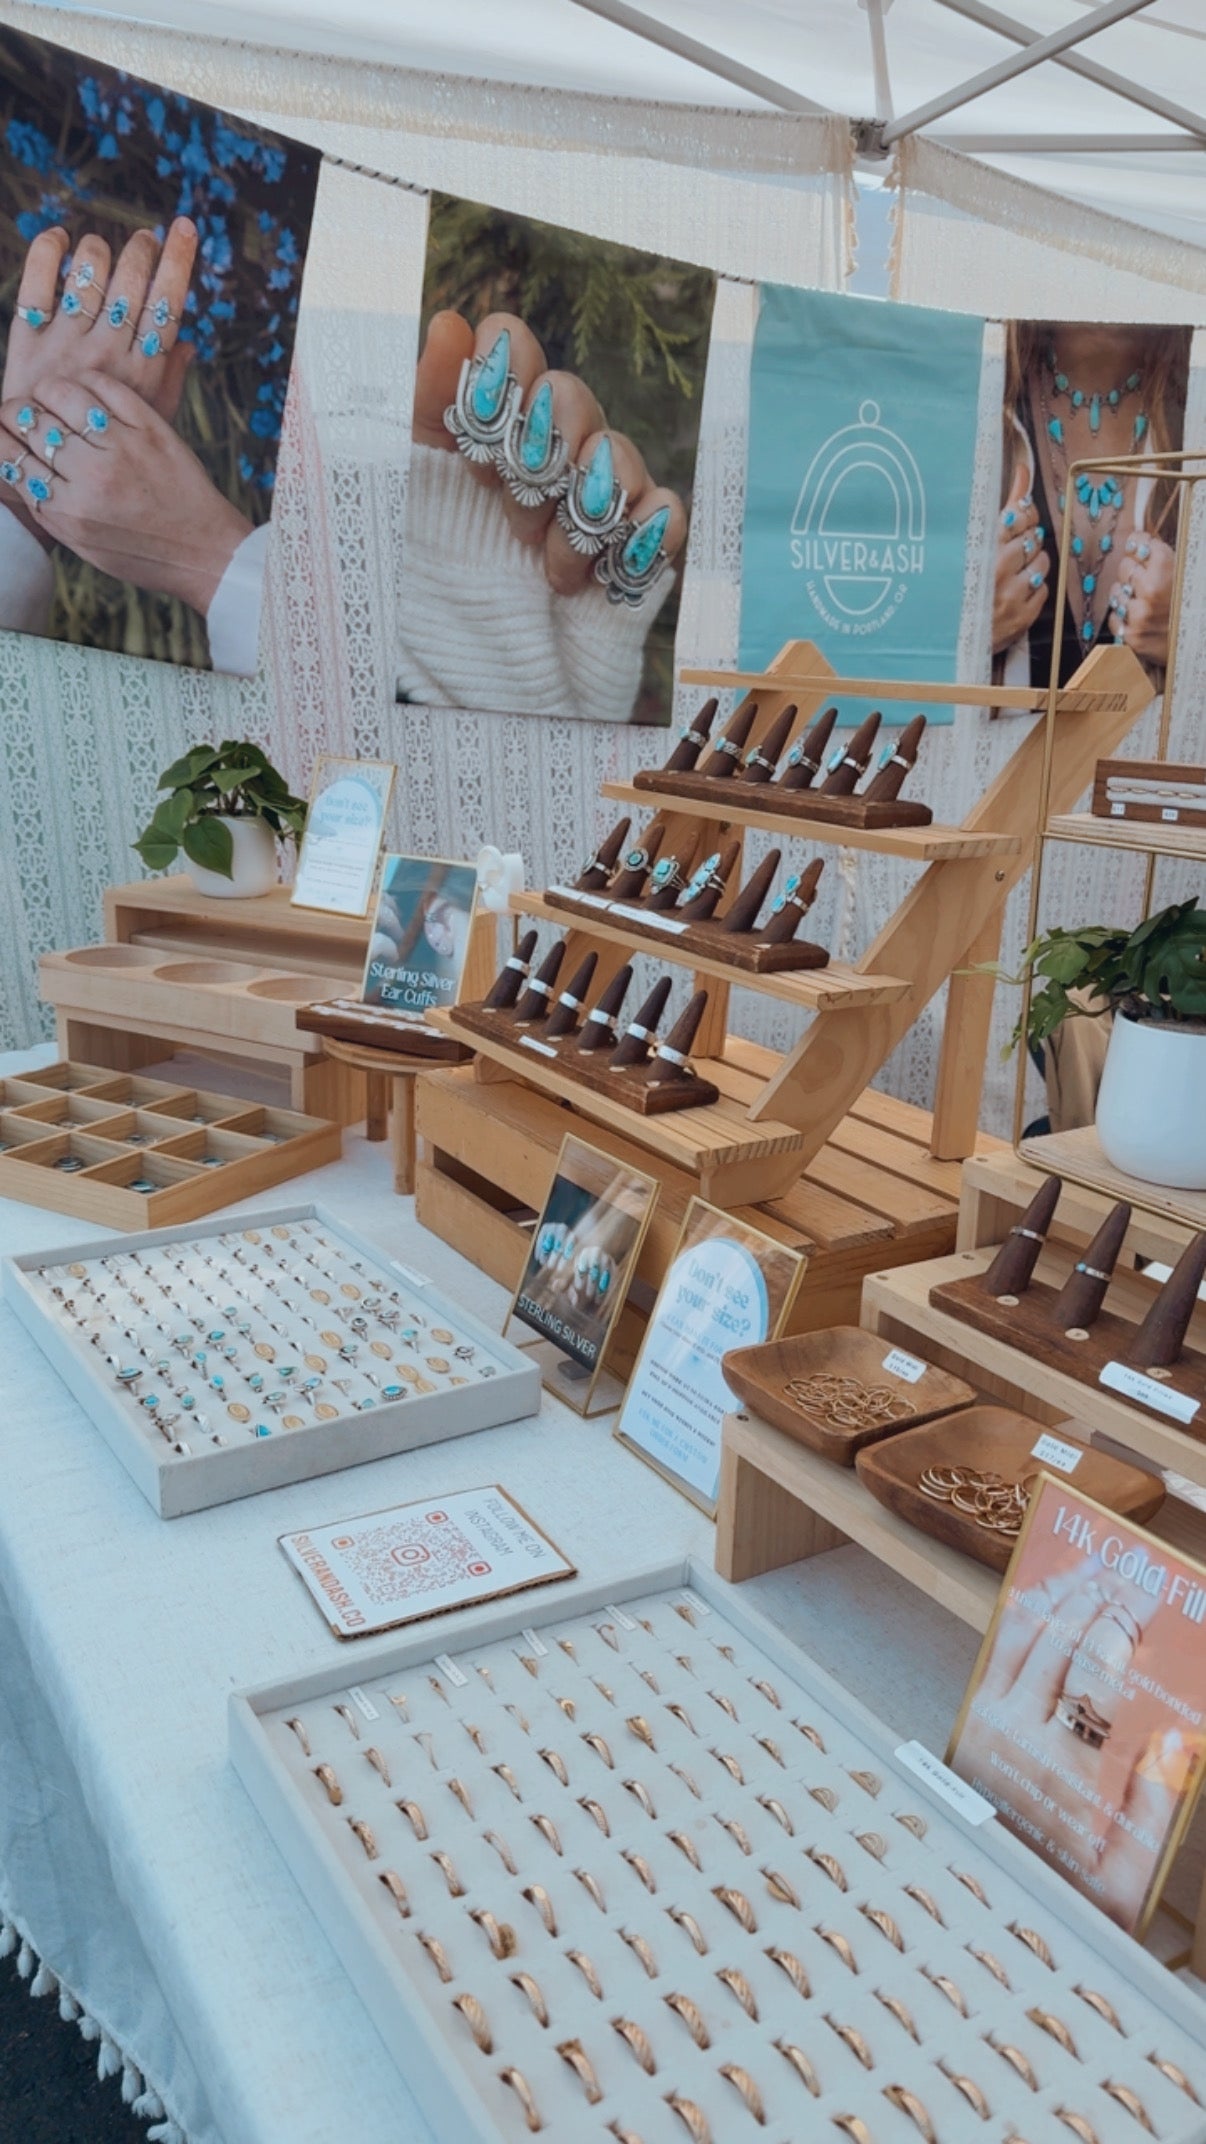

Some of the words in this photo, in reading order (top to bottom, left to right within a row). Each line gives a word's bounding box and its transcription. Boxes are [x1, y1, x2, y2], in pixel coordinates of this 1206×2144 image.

[790, 539, 924, 574] SILVER&ASH
[370, 962, 420, 988] Sterling
[420, 971, 457, 992] Silver
[381, 983, 404, 1001] Ear
[404, 988, 437, 1006] Cuffs
[689, 1259, 724, 1293] Don't
[725, 1285, 750, 1310] see
[517, 1294, 562, 1335] STERLING
[561, 1325, 597, 1359] SILVER
[675, 1284, 711, 1312] your
[711, 1305, 752, 1337] size?
[464, 1508, 514, 1557] INSTAGRAM
[483, 1497, 519, 1531] FOLLOW
[512, 1527, 536, 1545] ME
[525, 1543, 547, 1559] ON
[291, 1534, 367, 1627] SILVERANDASH.CO
